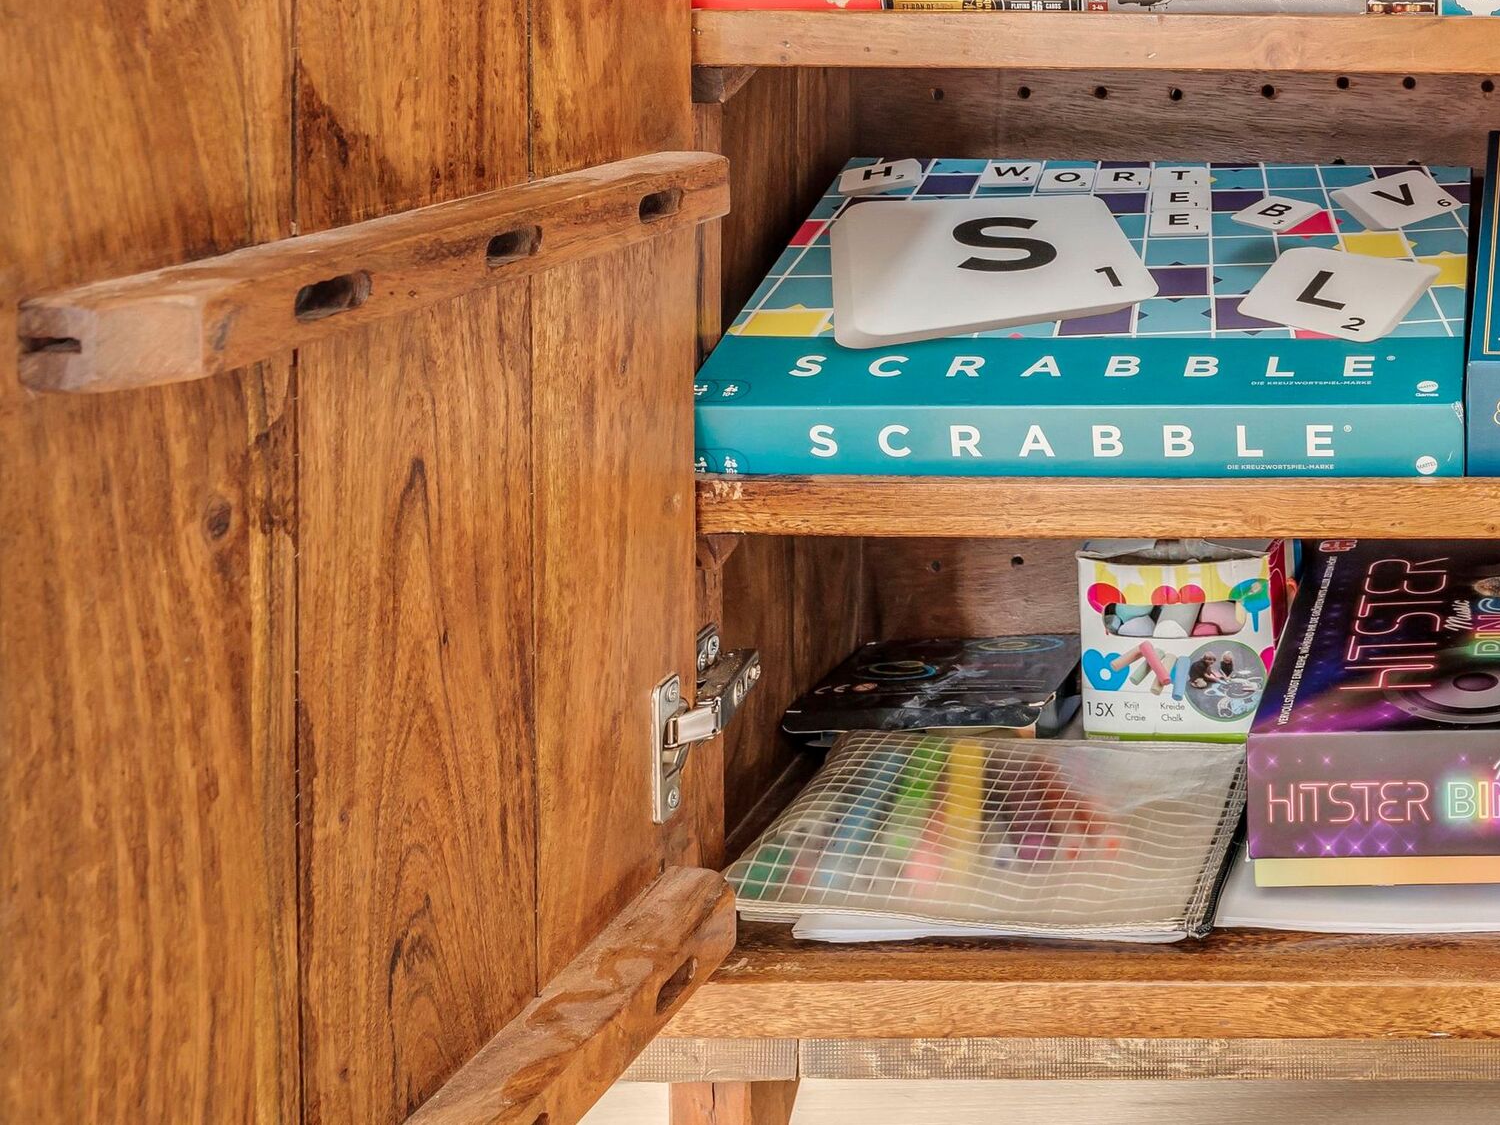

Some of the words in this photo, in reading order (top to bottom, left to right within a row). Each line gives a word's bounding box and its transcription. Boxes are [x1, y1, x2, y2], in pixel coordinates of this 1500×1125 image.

[1370, 183, 1415, 207] V
[1257, 204, 1293, 217] B
[952, 216, 1057, 271] S
[1093, 265, 1123, 287] 1
[1296, 270, 1346, 311] L
[1341, 317, 1366, 331] 2
[788, 355, 1376, 377] SCRABBLE
[808, 425, 1335, 458] SCRABBLE
[1340, 557, 1449, 690] HITSTER
[1444, 599, 1470, 632] Music
[1087, 701, 1115, 717] 15X
[1125, 713, 1146, 722] Craie
[1160, 702, 1186, 711] Kreide
[1161, 713, 1184, 722] Chalk
[1267, 781, 1430, 824] HITSTER
